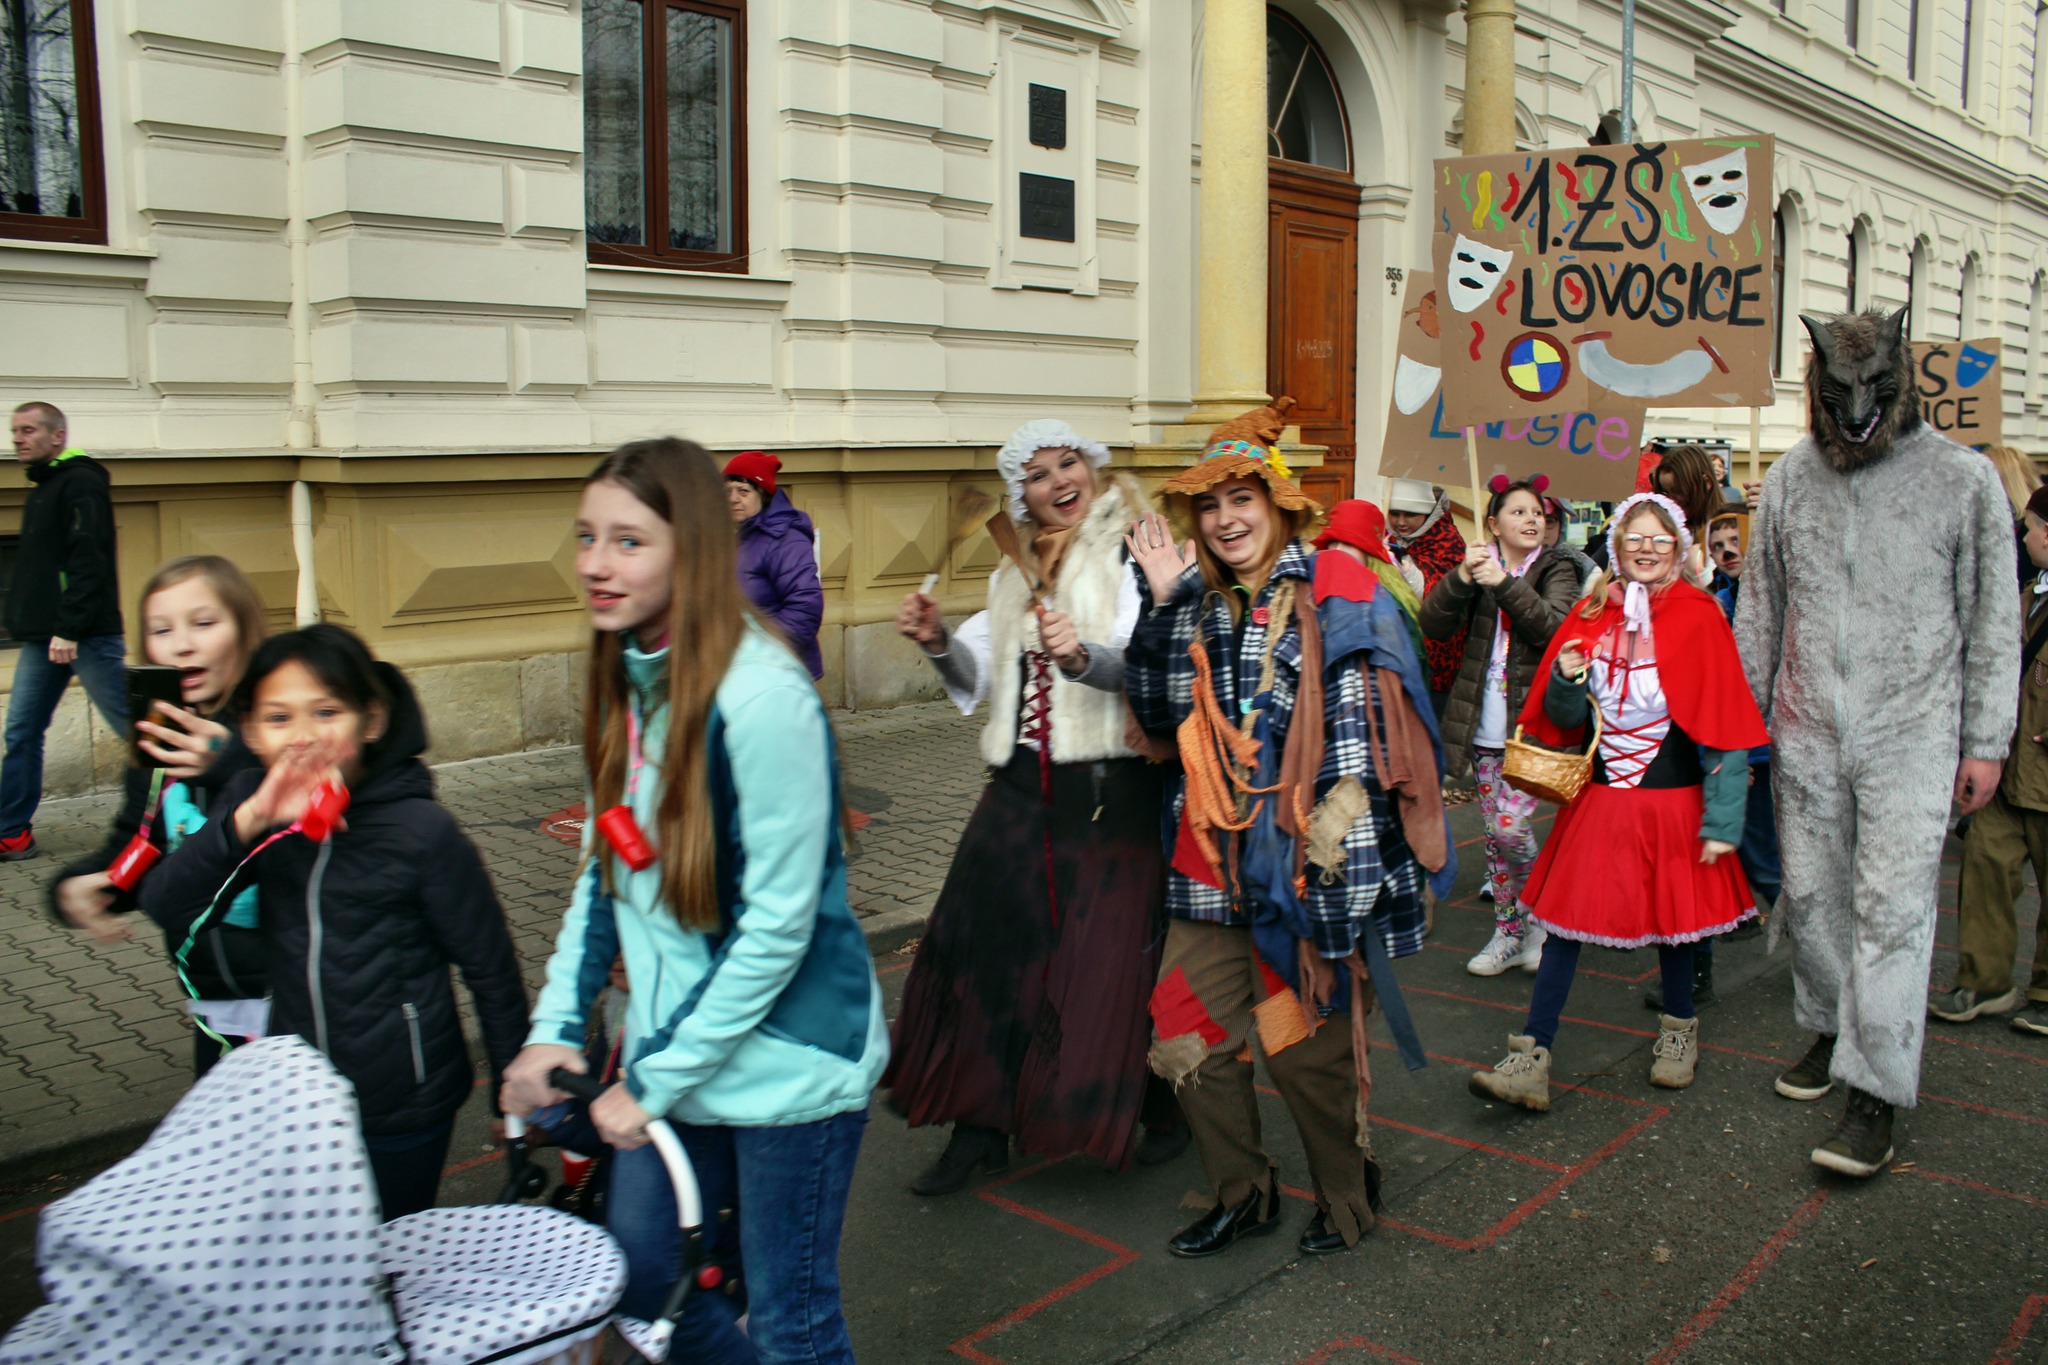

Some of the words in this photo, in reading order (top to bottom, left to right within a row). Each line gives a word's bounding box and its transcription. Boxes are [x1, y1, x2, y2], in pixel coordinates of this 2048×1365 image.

[1511, 143, 1667, 254] 1.ZŠ
[1385, 266, 1403, 282] 355
[1390, 281, 1397, 296] 2
[1520, 262, 1765, 327] LOVOSICE
[1917, 344, 1950, 398] Š
[1923, 397, 1979, 431] ICE
